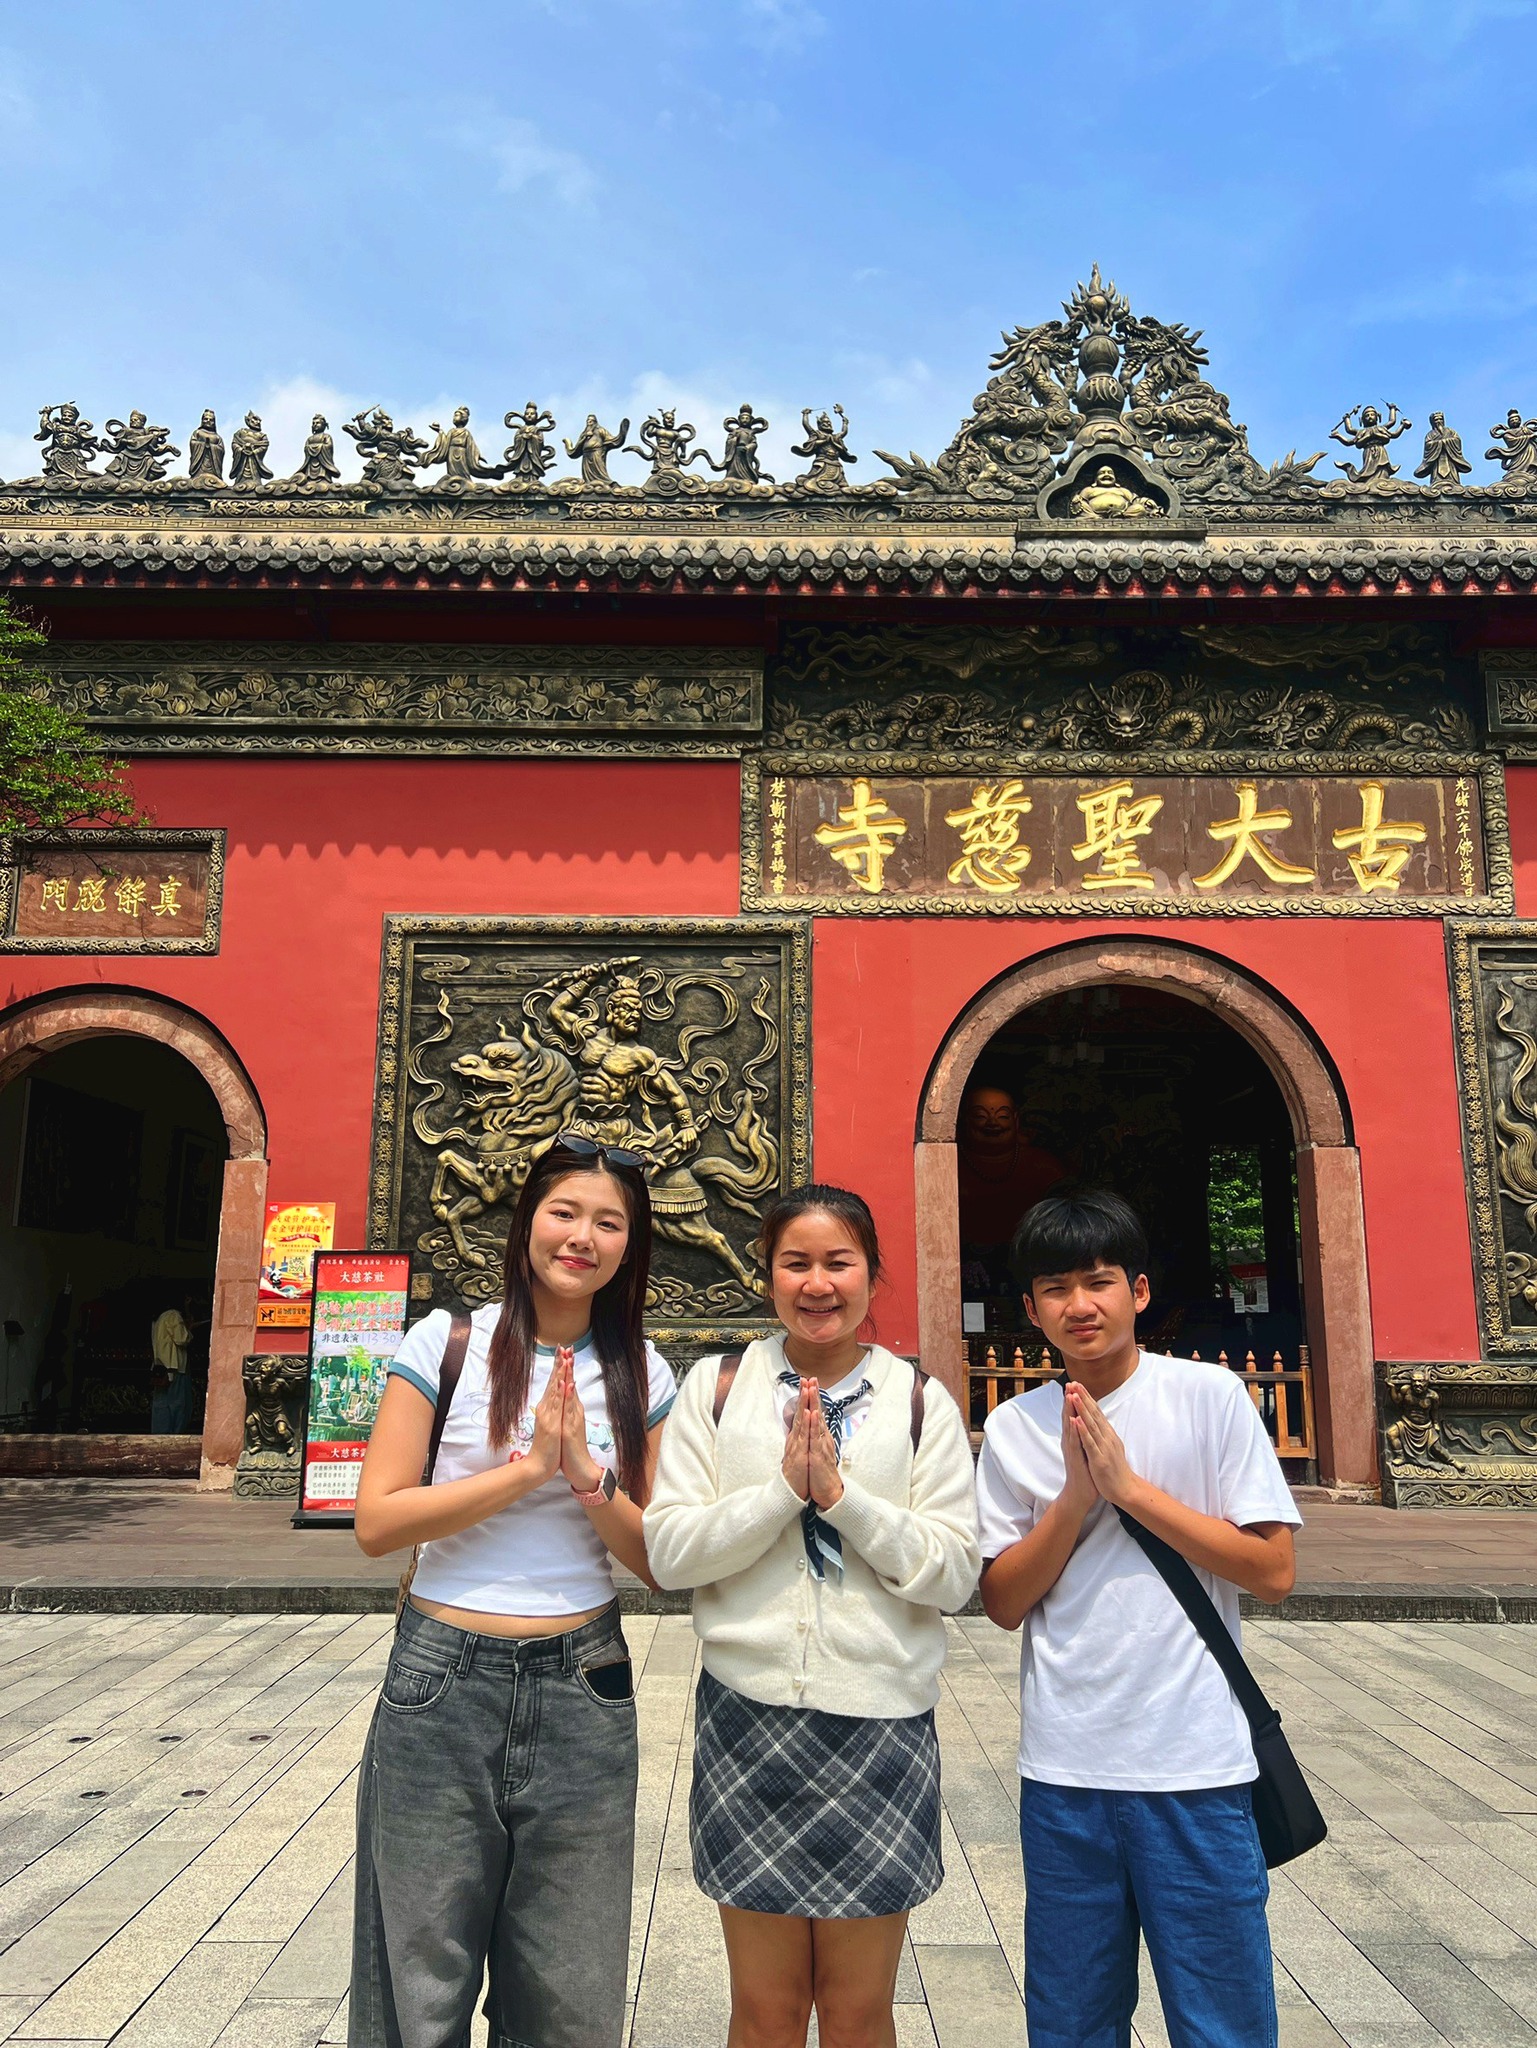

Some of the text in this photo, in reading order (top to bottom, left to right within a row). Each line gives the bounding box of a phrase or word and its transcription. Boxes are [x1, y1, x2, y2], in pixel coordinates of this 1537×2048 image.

[813, 777, 1428, 893] 古大聖慈寺
[340, 1271, 385, 1283] 大慈茶社
